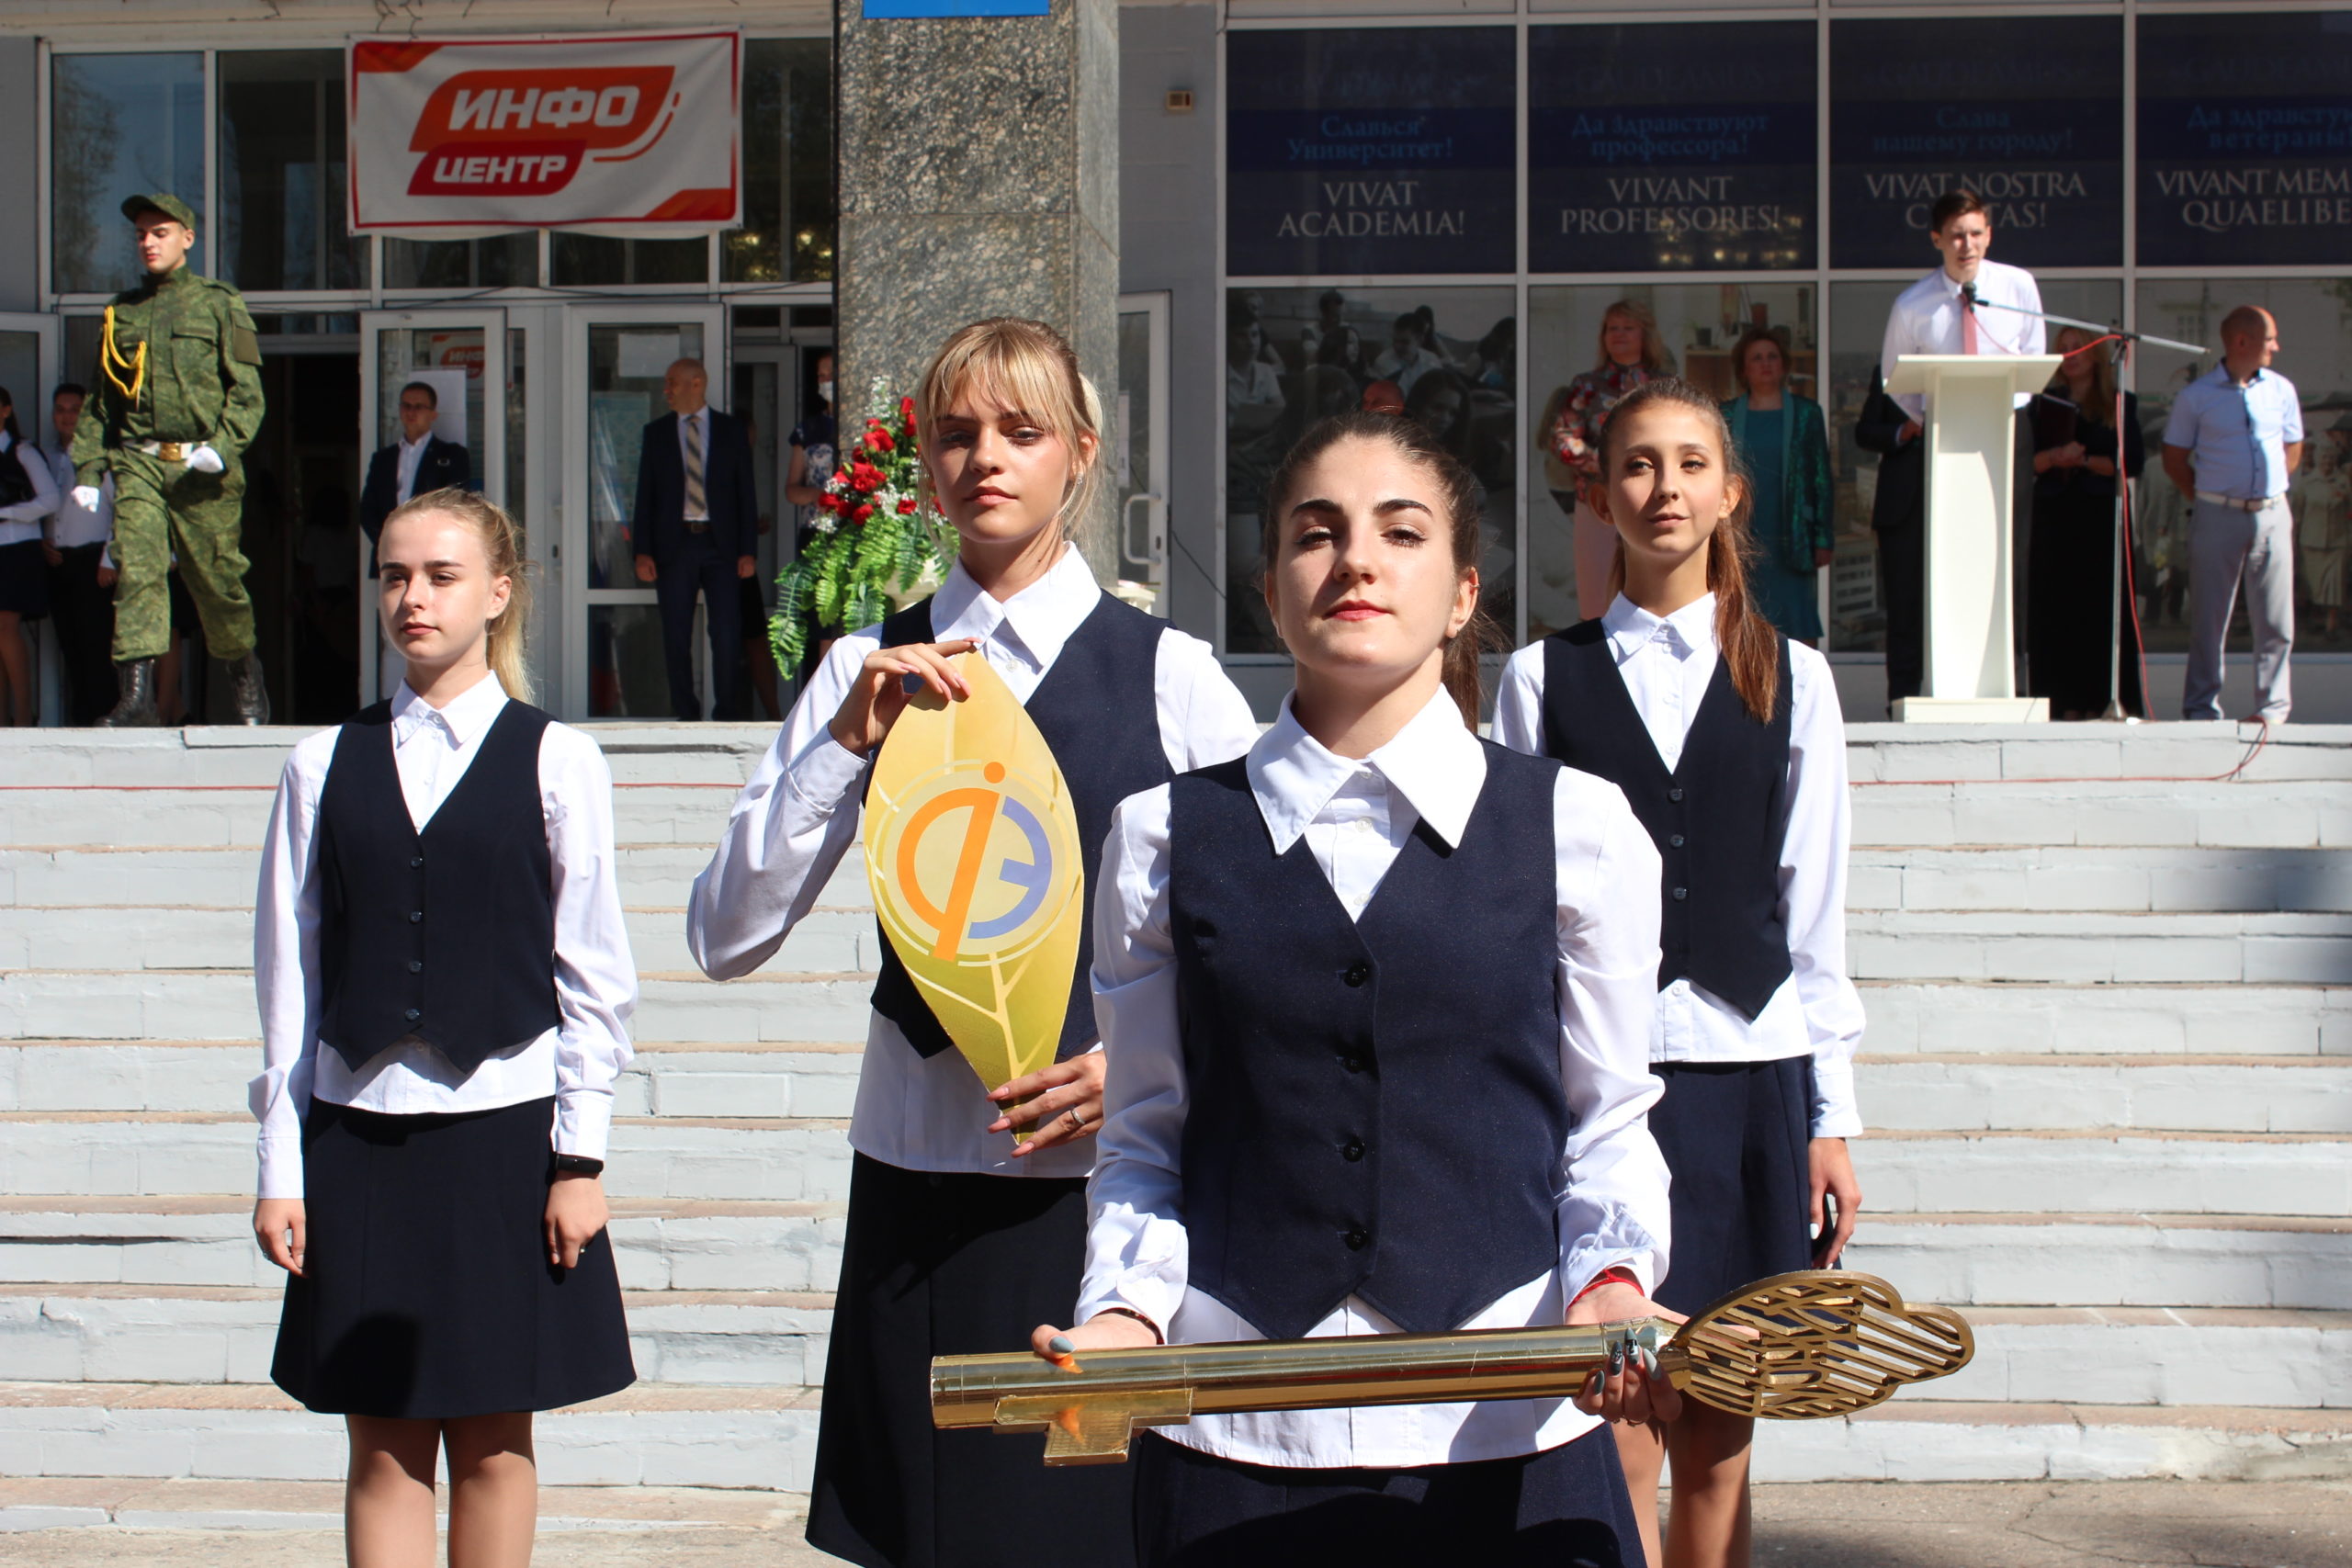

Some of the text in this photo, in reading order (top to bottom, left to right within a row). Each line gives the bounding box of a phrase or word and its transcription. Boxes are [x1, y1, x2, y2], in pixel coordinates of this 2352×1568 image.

[448, 85, 640, 130] ИНФО
[1935, 107, 2011, 130] Слава
[2187, 103, 2221, 130] Да
[1320, 115, 1421, 138] Славься
[1571, 112, 1770, 138] Да здравствуют
[1286, 136, 1453, 166] Университет!
[1590, 134, 1749, 163] профессора!
[1872, 128, 2074, 156] нашему городу!
[434, 155, 567, 183] ЦЕНТР
[2154, 168, 2271, 197] VIVANT
[1322, 180, 1420, 208] VIVAT
[1606, 175, 1734, 204] VIVANT
[1864, 170, 2088, 198] VIVAT NOSTRA
[1276, 209, 1465, 238] ACADEMIA!
[1560, 204, 1781, 234] PROFESSORES!
[1905, 201, 2048, 230] CTAS!
